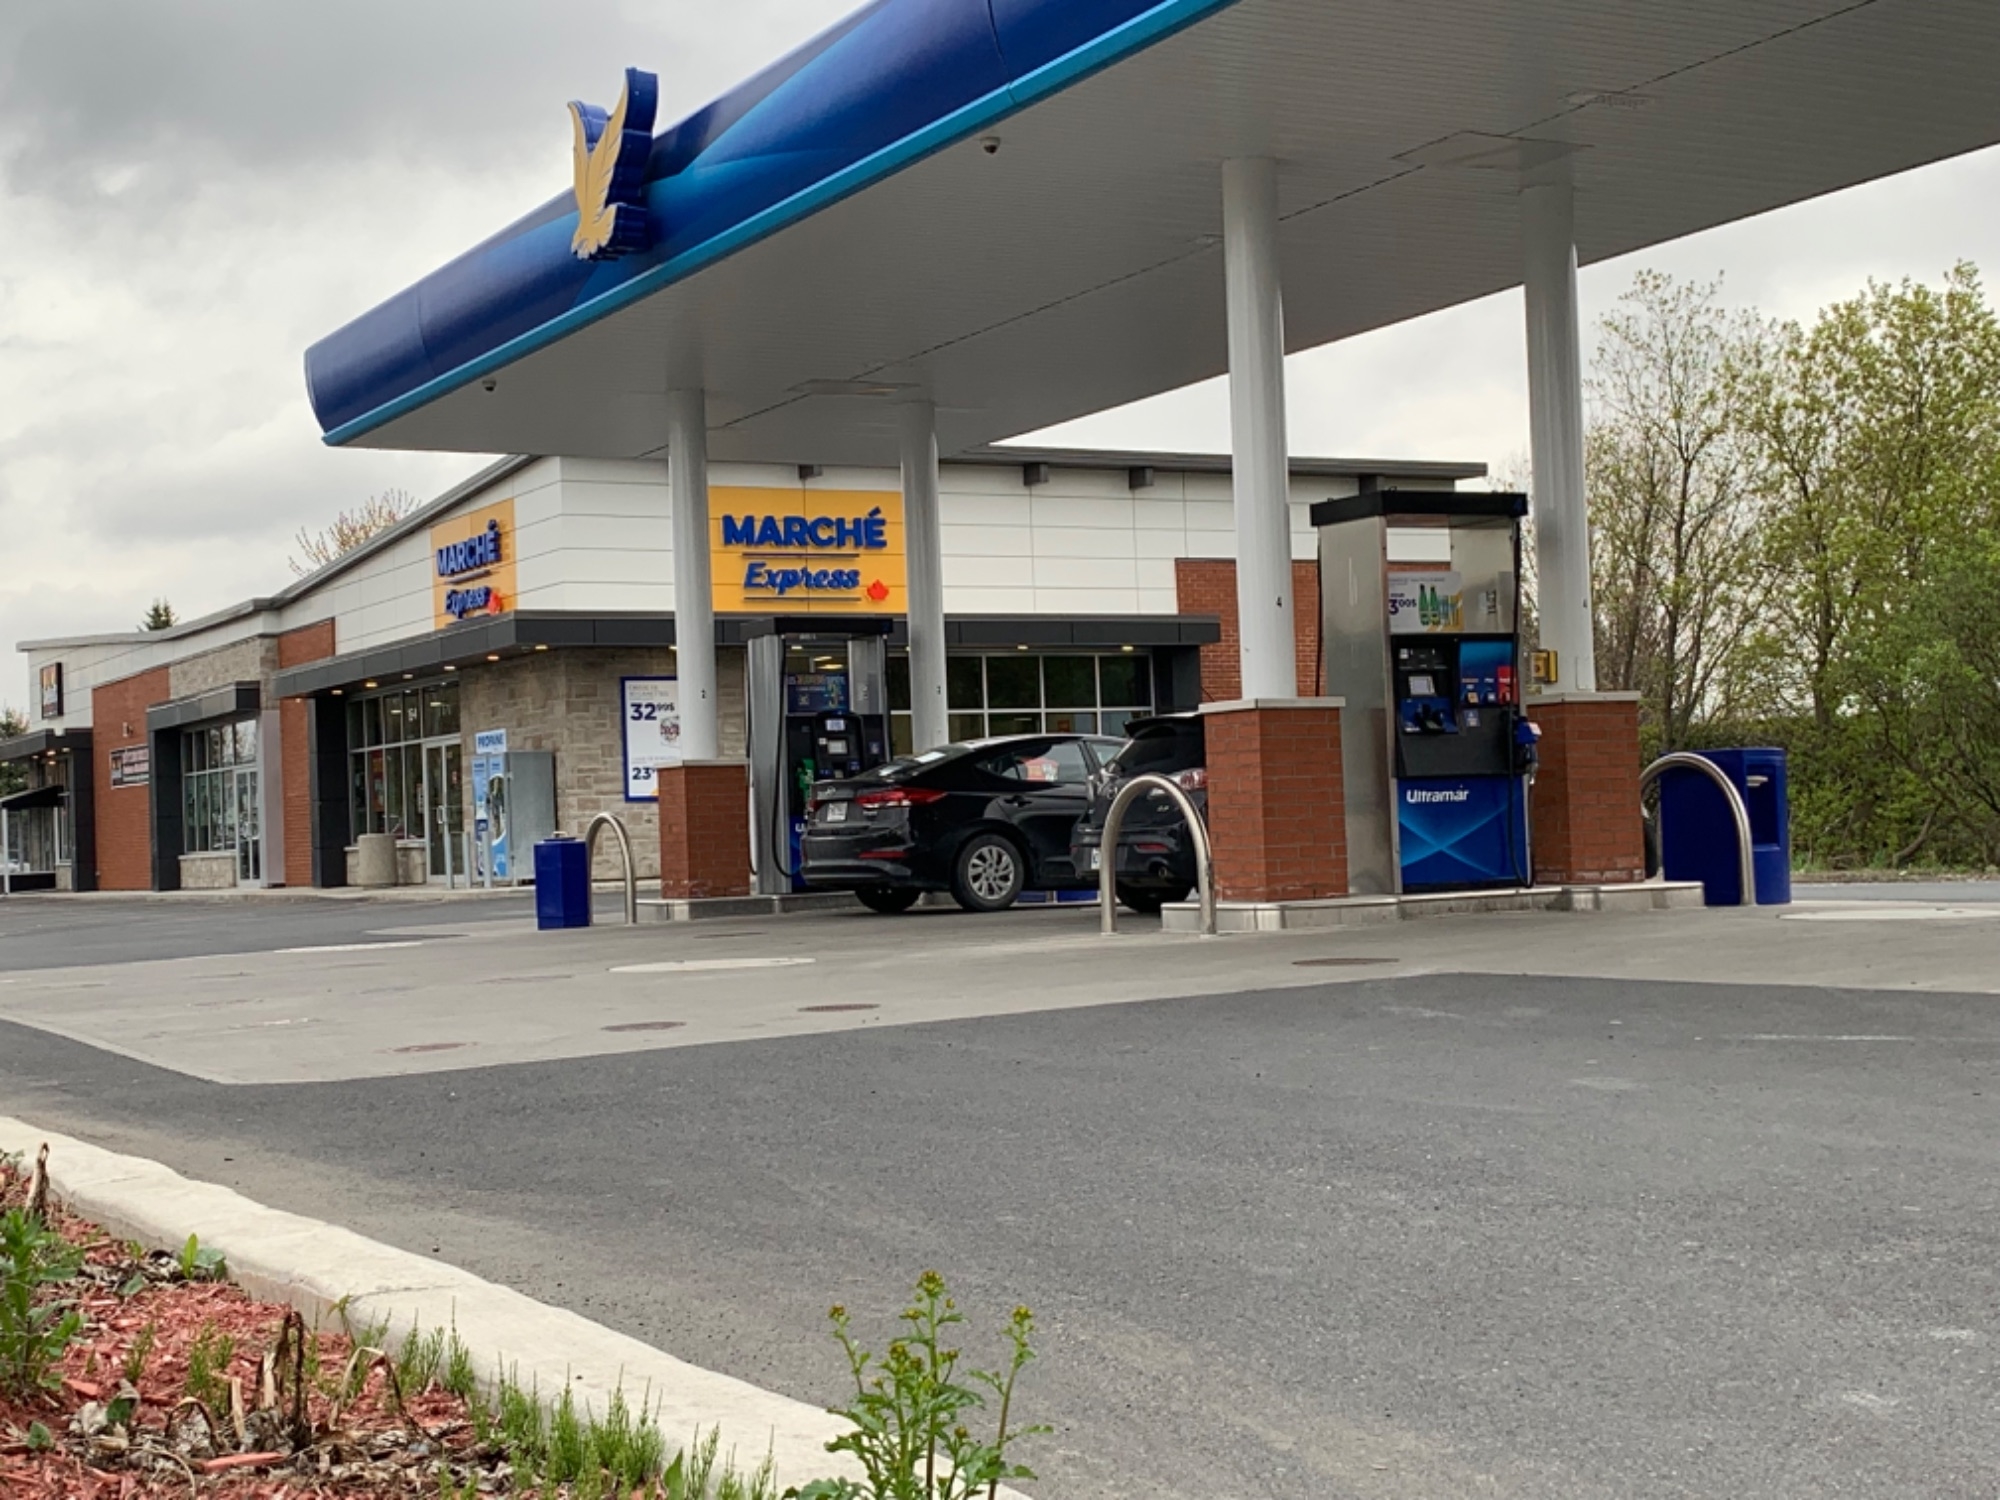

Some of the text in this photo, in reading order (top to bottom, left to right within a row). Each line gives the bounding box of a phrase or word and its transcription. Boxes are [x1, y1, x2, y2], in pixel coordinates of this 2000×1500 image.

[722, 506, 888, 549] MARCHÉ
[436, 519, 502, 577] MARCHÉ
[743, 562, 861, 596] Express
[445, 587, 493, 620] Express
[1406, 789, 1469, 804] Ultramar
